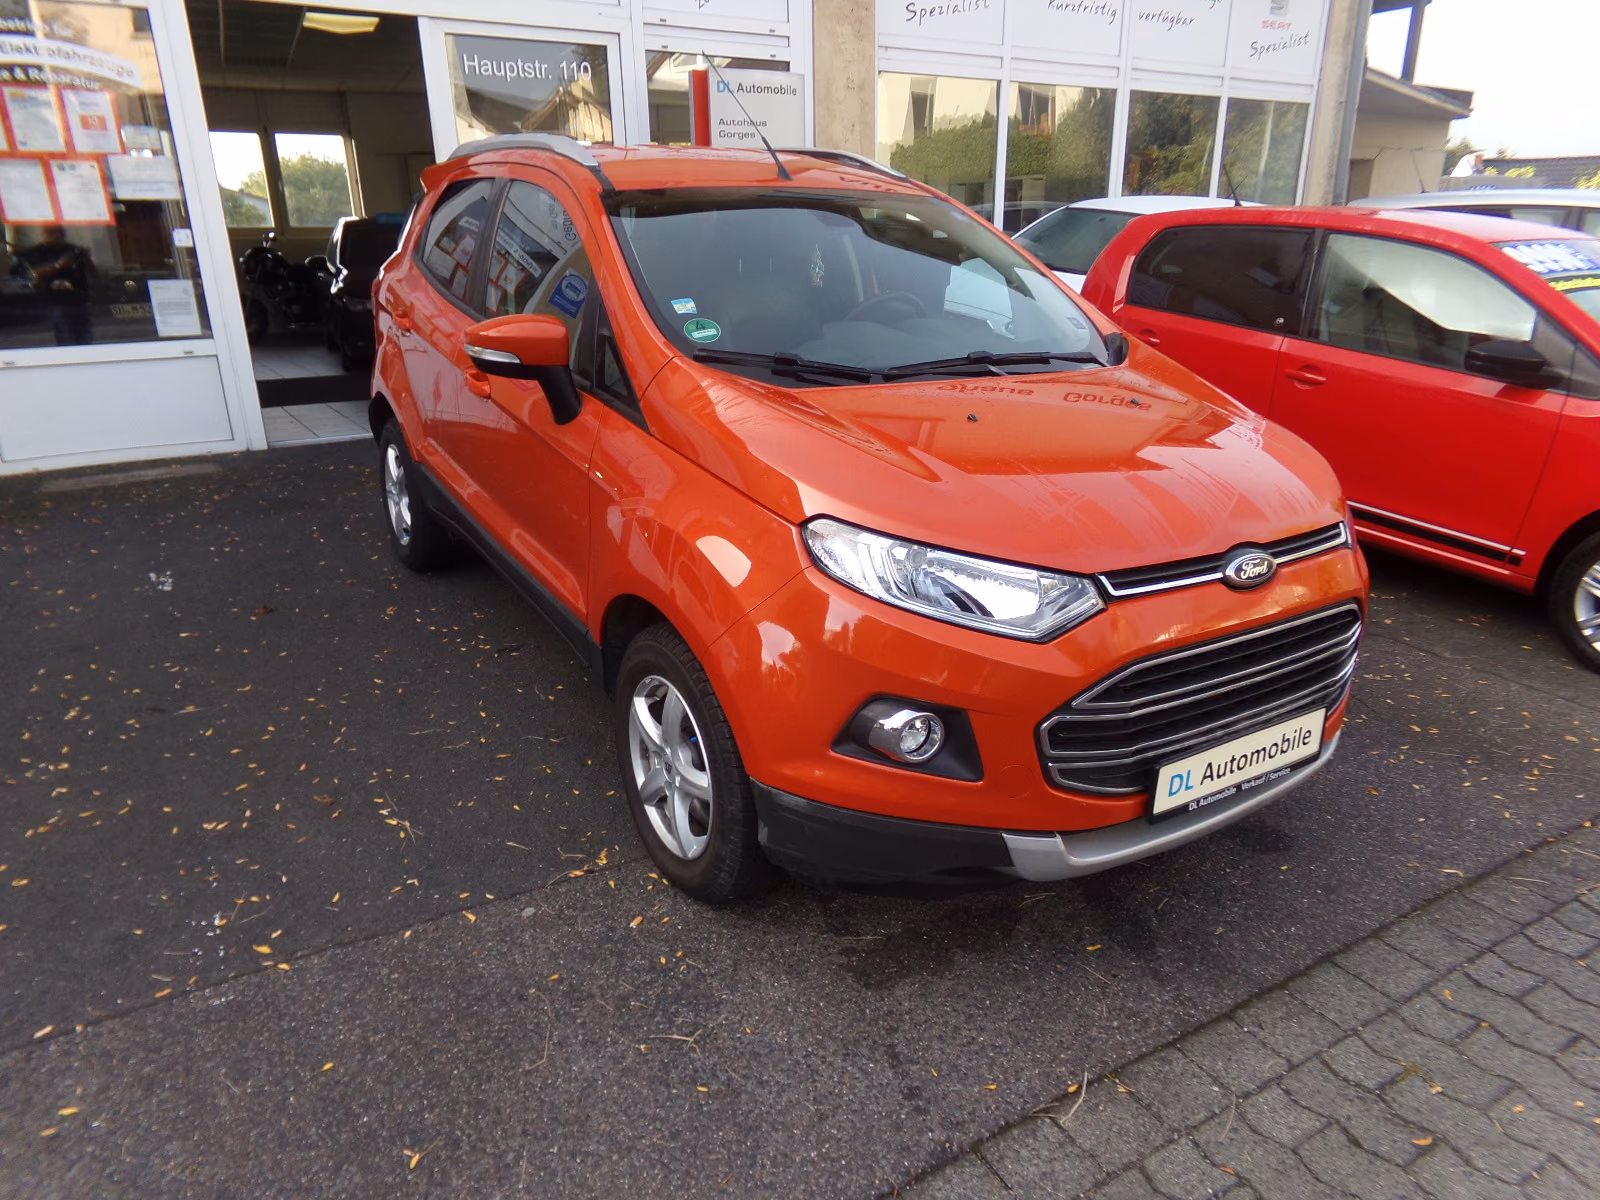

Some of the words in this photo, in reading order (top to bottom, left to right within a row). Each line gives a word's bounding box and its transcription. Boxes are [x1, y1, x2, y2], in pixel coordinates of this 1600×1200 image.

[1138, 9, 1195, 31] verfügbar
[1249, 30, 1310, 60] Spezialist
[463, 54, 552, 82] Hauptstr.
[559, 60, 592, 81] 110
[717, 80, 733, 93] DL
[736, 82, 797, 95] Automobile
[718, 118, 767, 127] Autohaus
[718, 129, 755, 140] Gorges
[1240, 559, 1268, 579] Ford
[1168, 769, 1194, 797] DL
[1200, 727, 1312, 786] Automobile
[1188, 801, 1198, 811] DL
[1199, 787, 1237, 807] Automobile
[1269, 767, 1291, 781] Service
